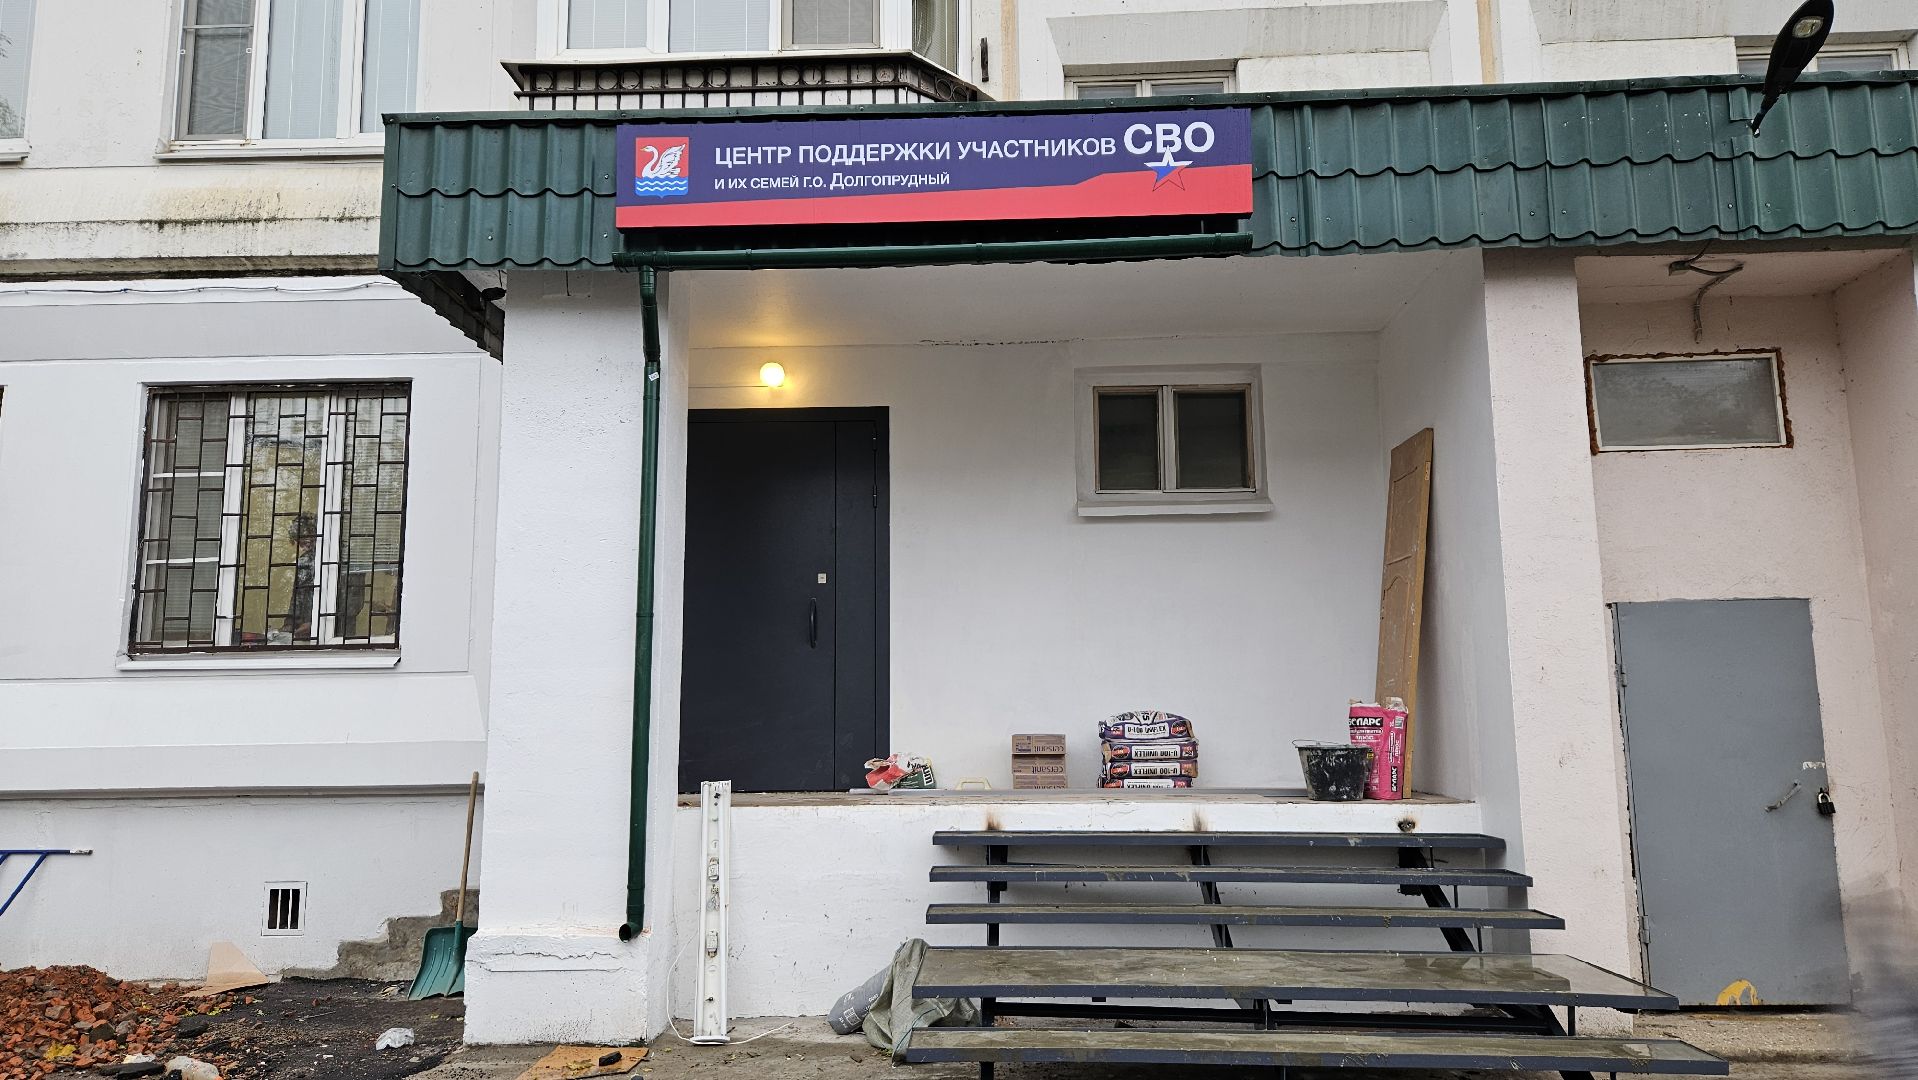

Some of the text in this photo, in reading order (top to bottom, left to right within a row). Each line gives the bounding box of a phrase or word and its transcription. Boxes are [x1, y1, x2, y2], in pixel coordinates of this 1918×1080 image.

[715, 121, 1215, 168] ЦЕНТР ПОДДЕРЖКИ УЧАСТНИКОВ СВО
[714, 178, 725, 190] И
[728, 177, 747, 190] ИХ
[750, 174, 799, 189] СЕМЕЙ
[830, 172, 950, 190] ДОЛГОПРУДНЫЙ
[1031, 765, 1064, 774] cersanit
[1134, 766, 1158, 774] UNIFLEX
